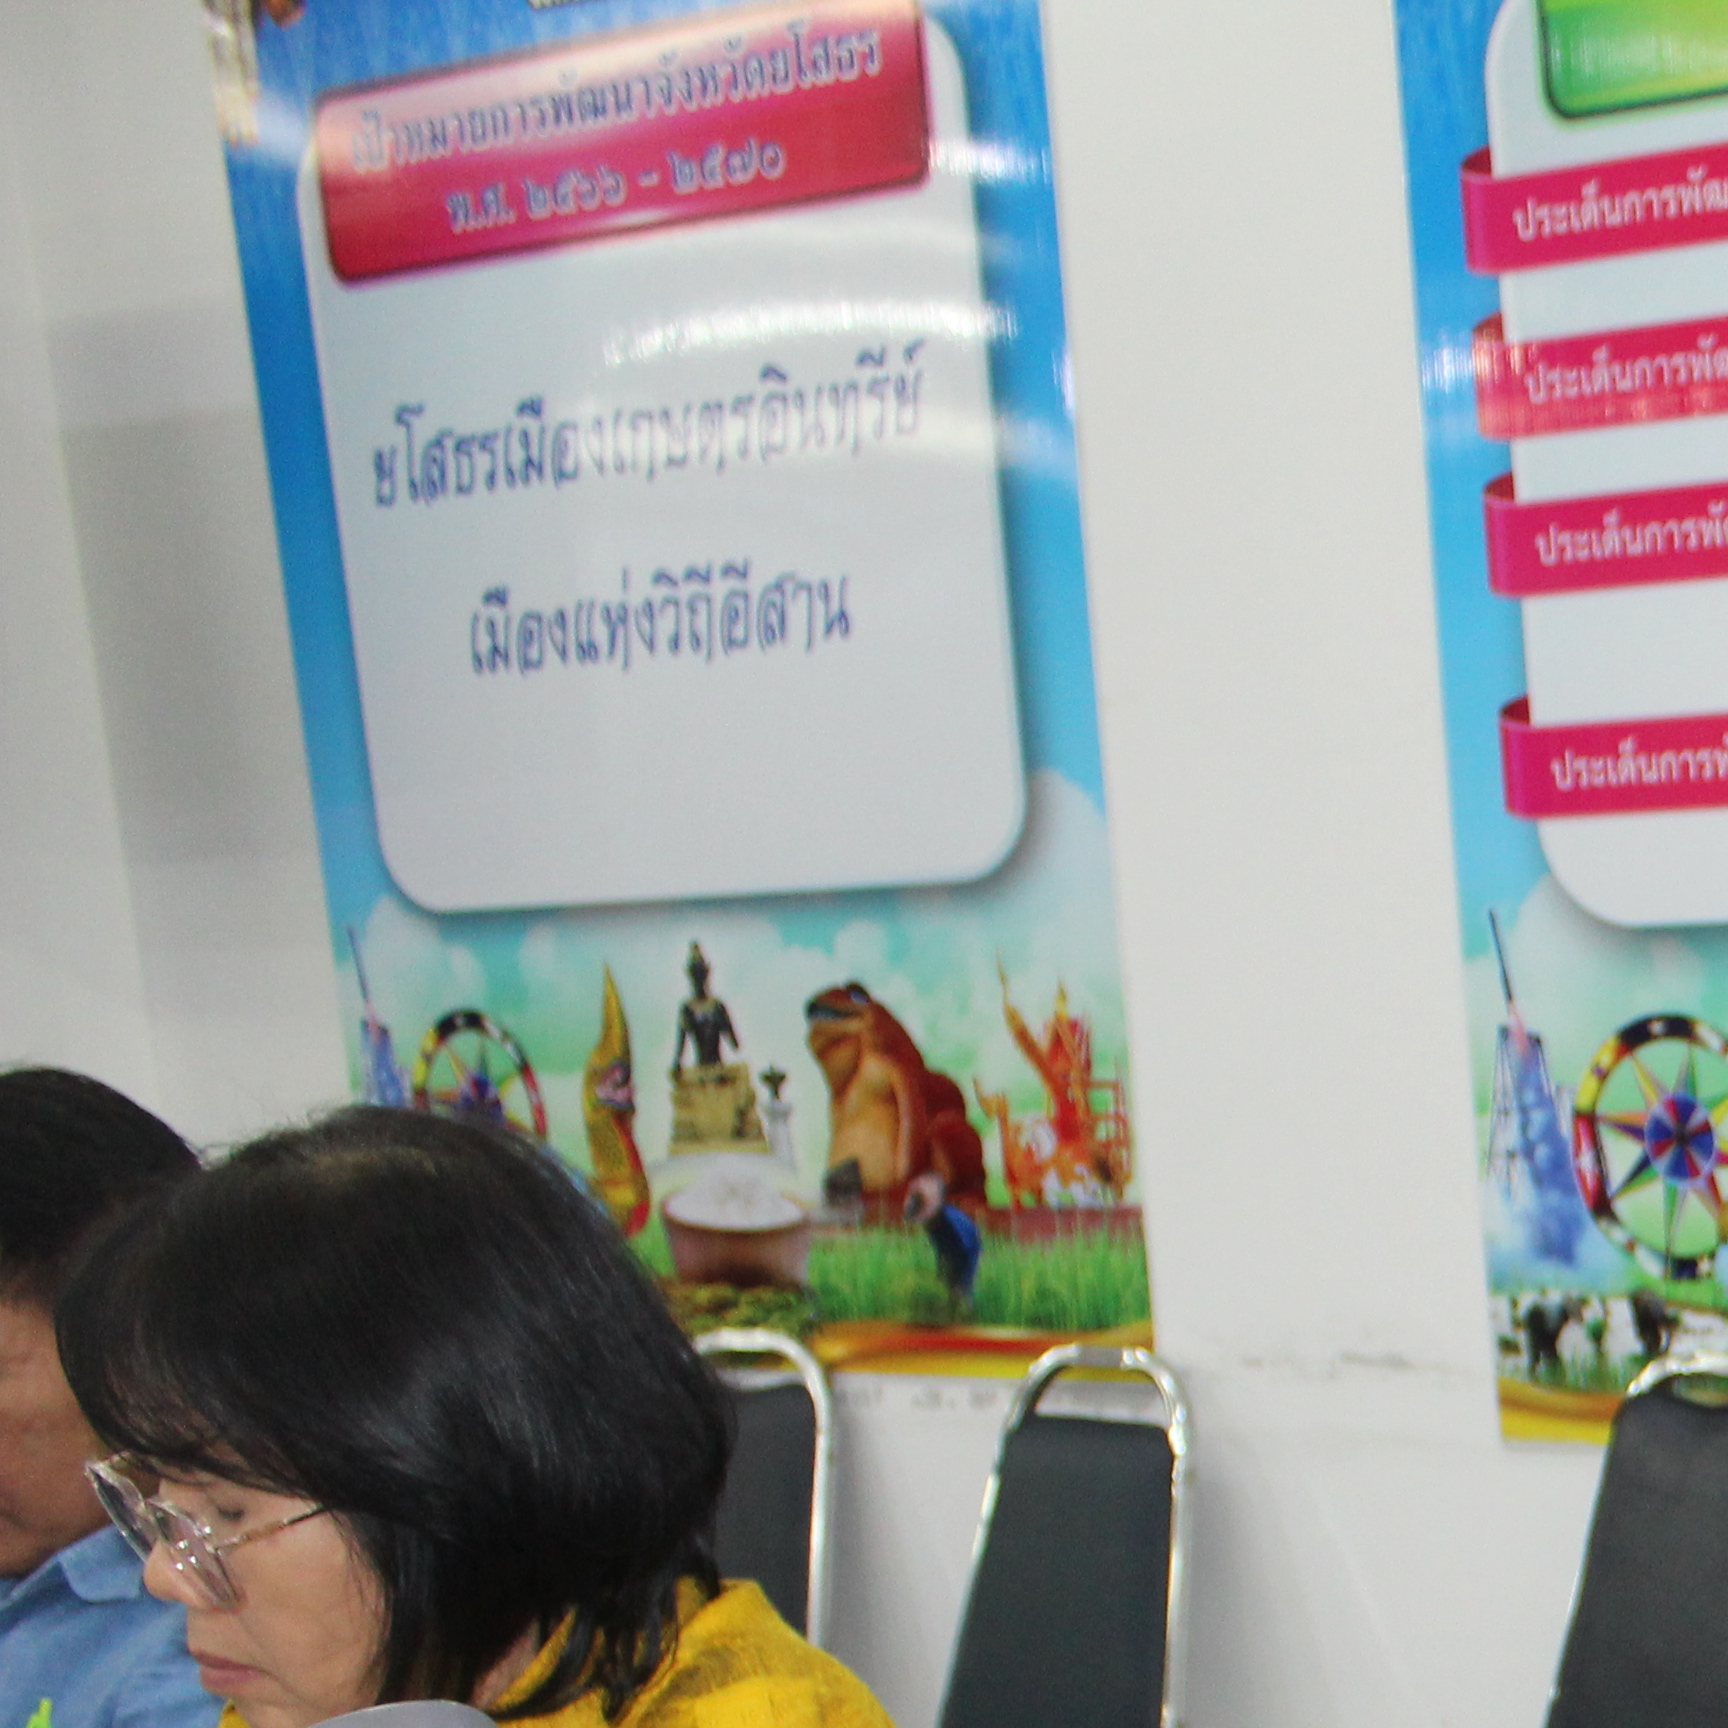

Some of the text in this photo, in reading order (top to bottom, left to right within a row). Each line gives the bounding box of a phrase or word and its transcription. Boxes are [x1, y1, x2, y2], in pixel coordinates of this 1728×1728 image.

[372, 340, 925, 508] ยโสธรเมืองเกษตรอินทรีย์
[470, 558, 851, 676] เมืองแห่งวิถีอีสาน
